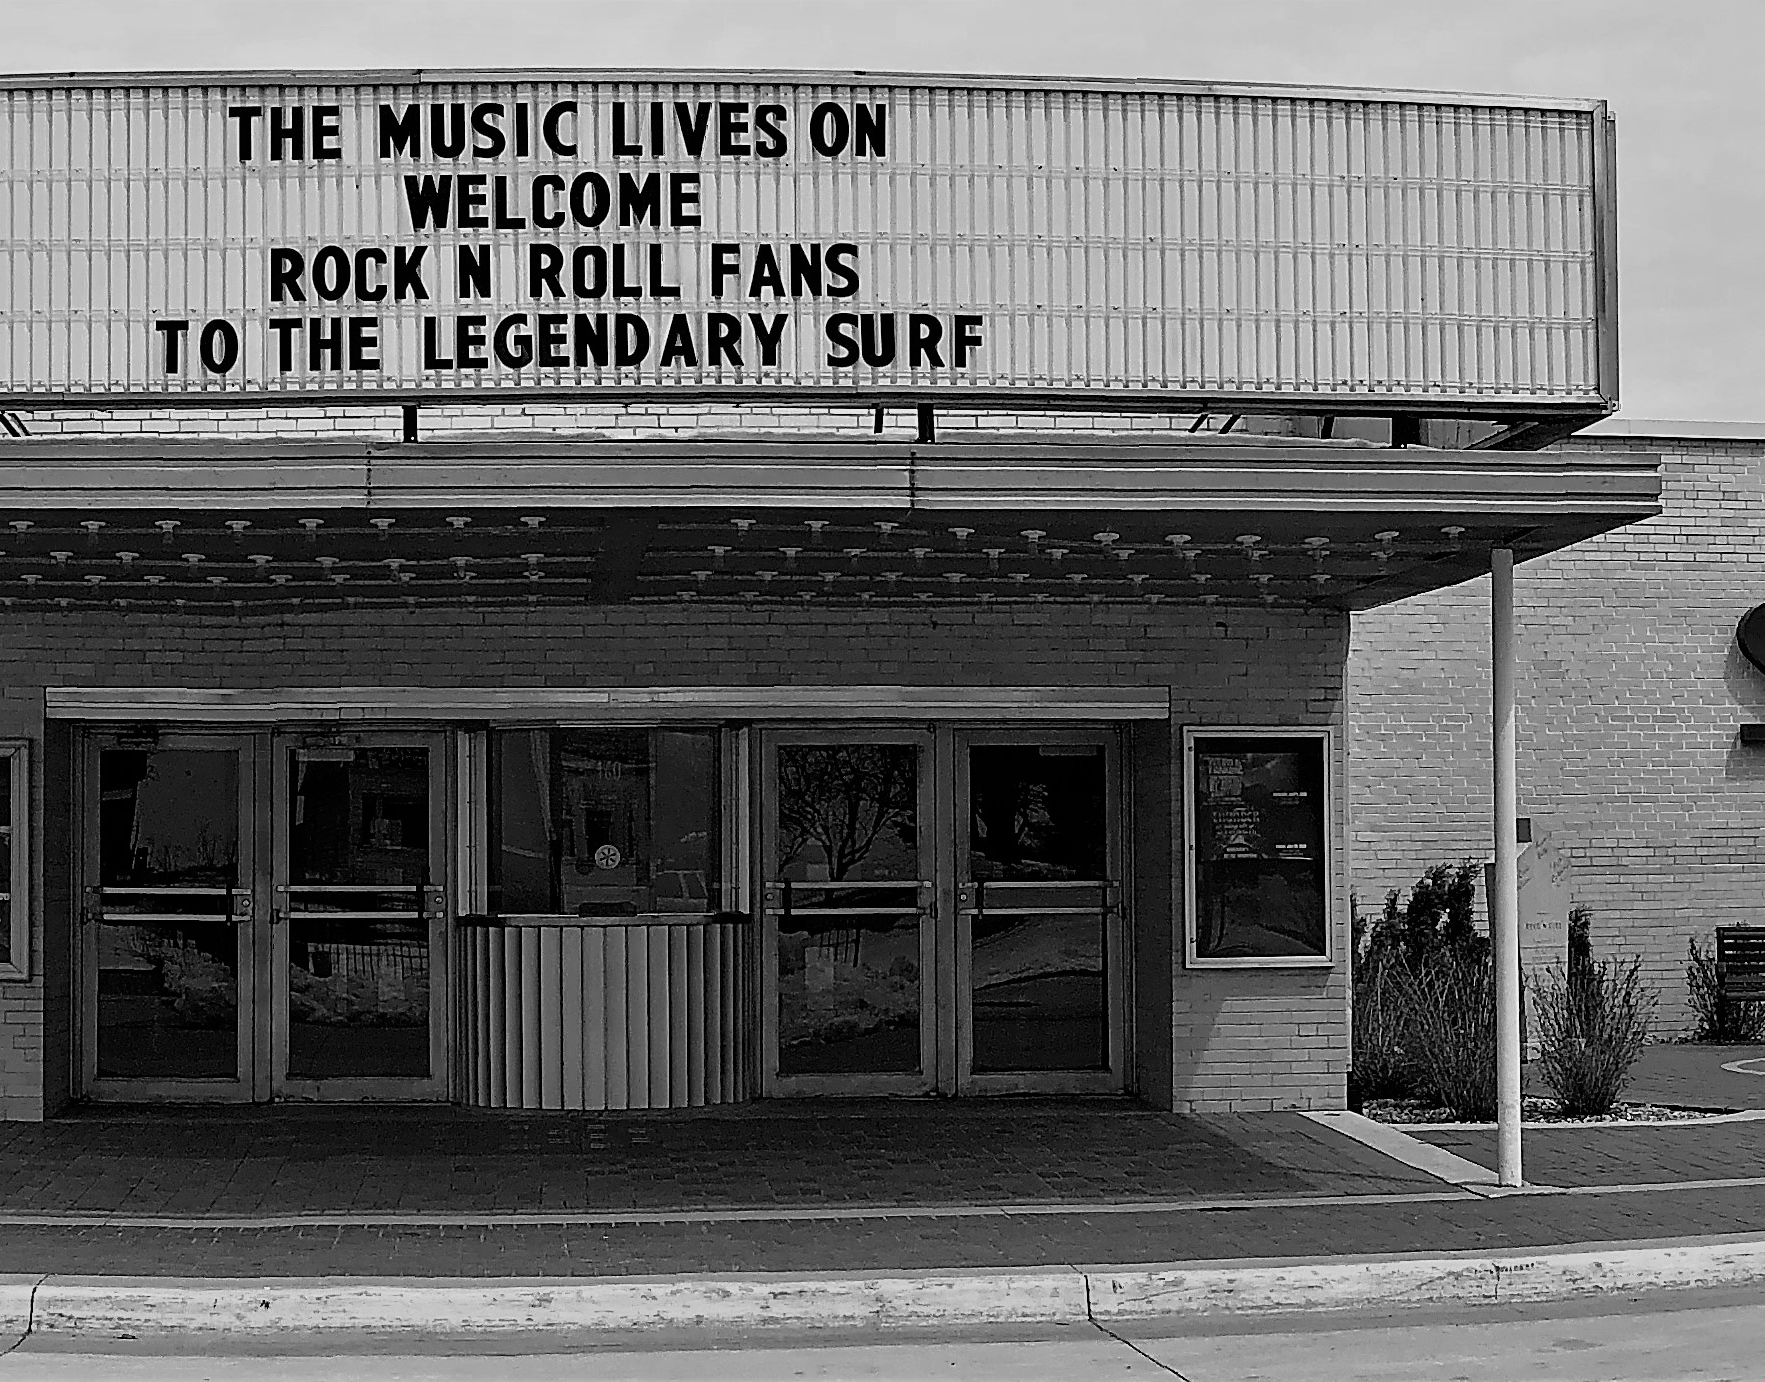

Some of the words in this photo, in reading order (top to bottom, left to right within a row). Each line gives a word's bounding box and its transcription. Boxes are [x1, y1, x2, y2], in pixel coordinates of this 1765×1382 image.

[229, 105, 341, 162] THE
[378, 100, 578, 159] MUSIC
[612, 101, 788, 158] LIVES
[809, 101, 886, 157] ON
[404, 171, 702, 233] WELCOME
[270, 244, 430, 302] ROCK
[458, 244, 492, 299] N
[529, 242, 681, 299] ROLL
[711, 242, 860, 299] FANS
[155, 317, 239, 375] TO
[269, 315, 382, 372] THE
[423, 312, 789, 370] LEGENDARY
[825, 311, 984, 368] SURF
